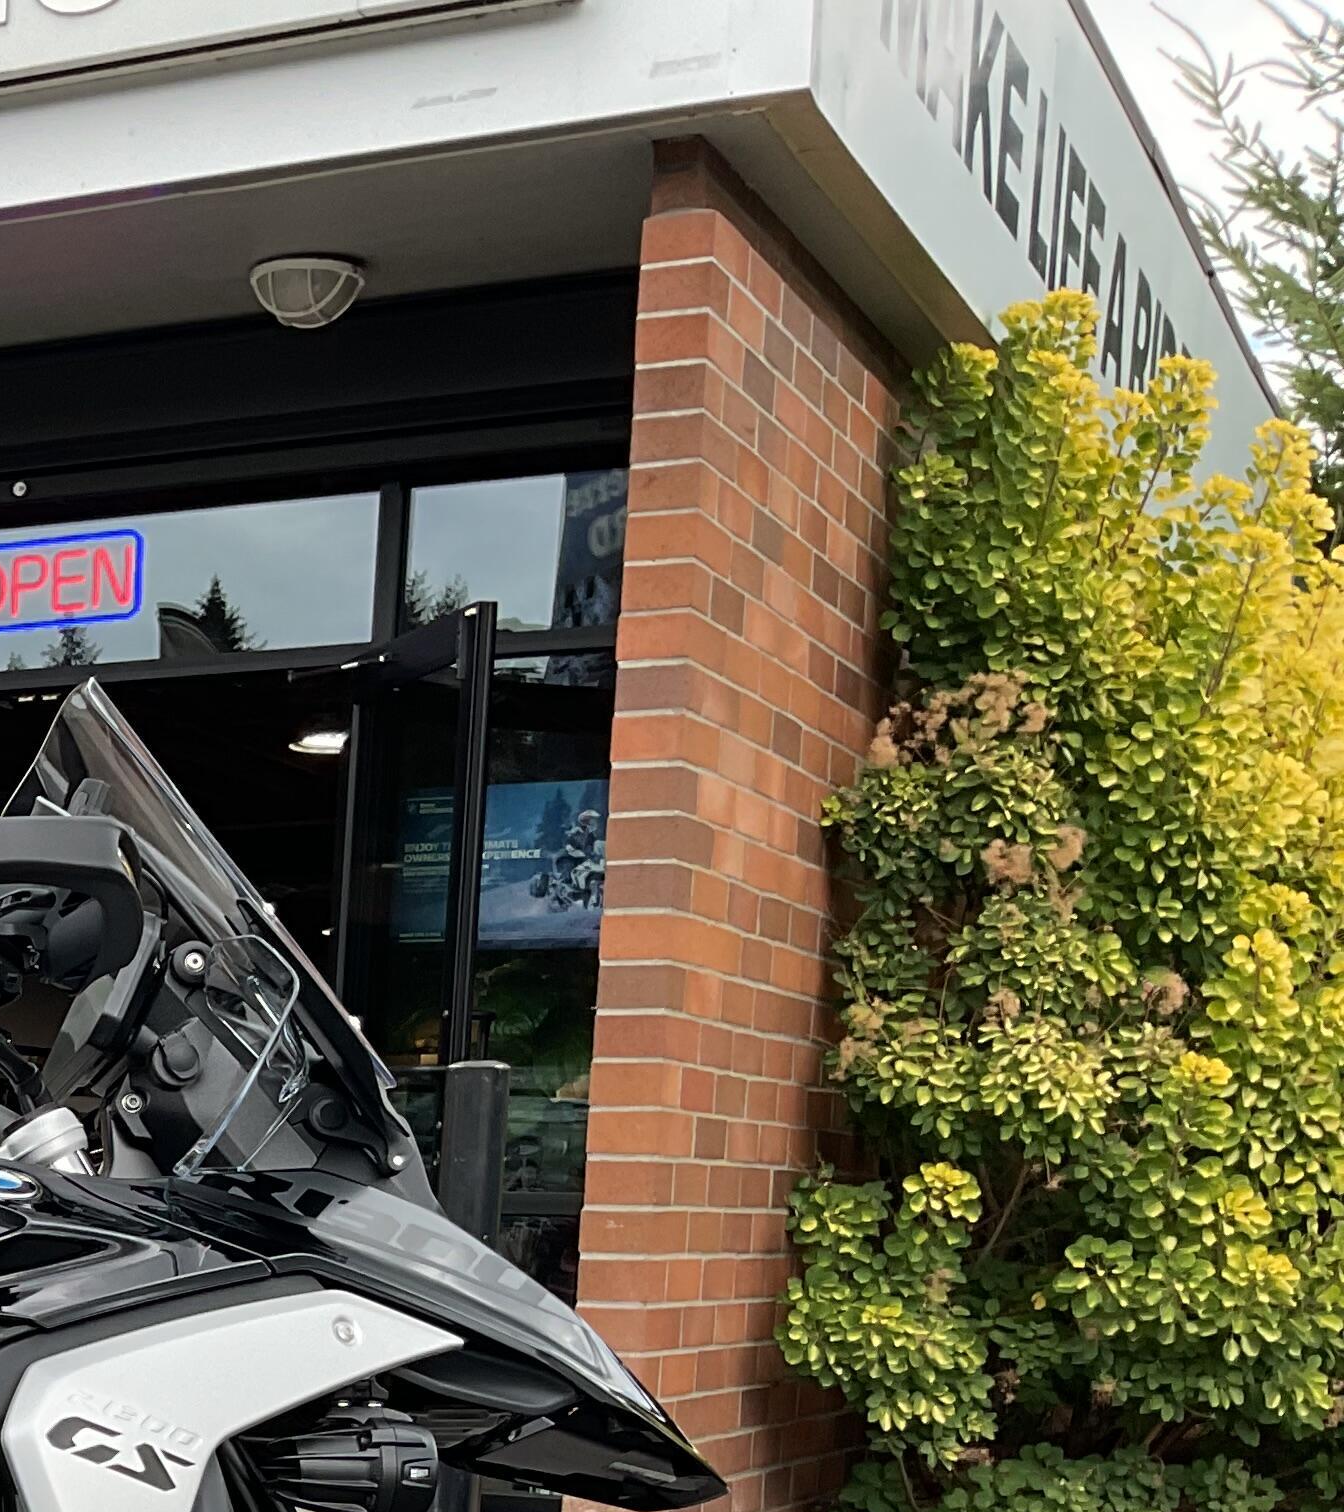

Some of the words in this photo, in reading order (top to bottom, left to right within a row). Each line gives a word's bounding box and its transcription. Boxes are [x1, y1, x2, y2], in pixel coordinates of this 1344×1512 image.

[1028, 87, 1107, 298] LIFE
[1100, 231, 1126, 388] A
[1129, 266, 1194, 392] RID
[45, 1415, 197, 1492] GS
